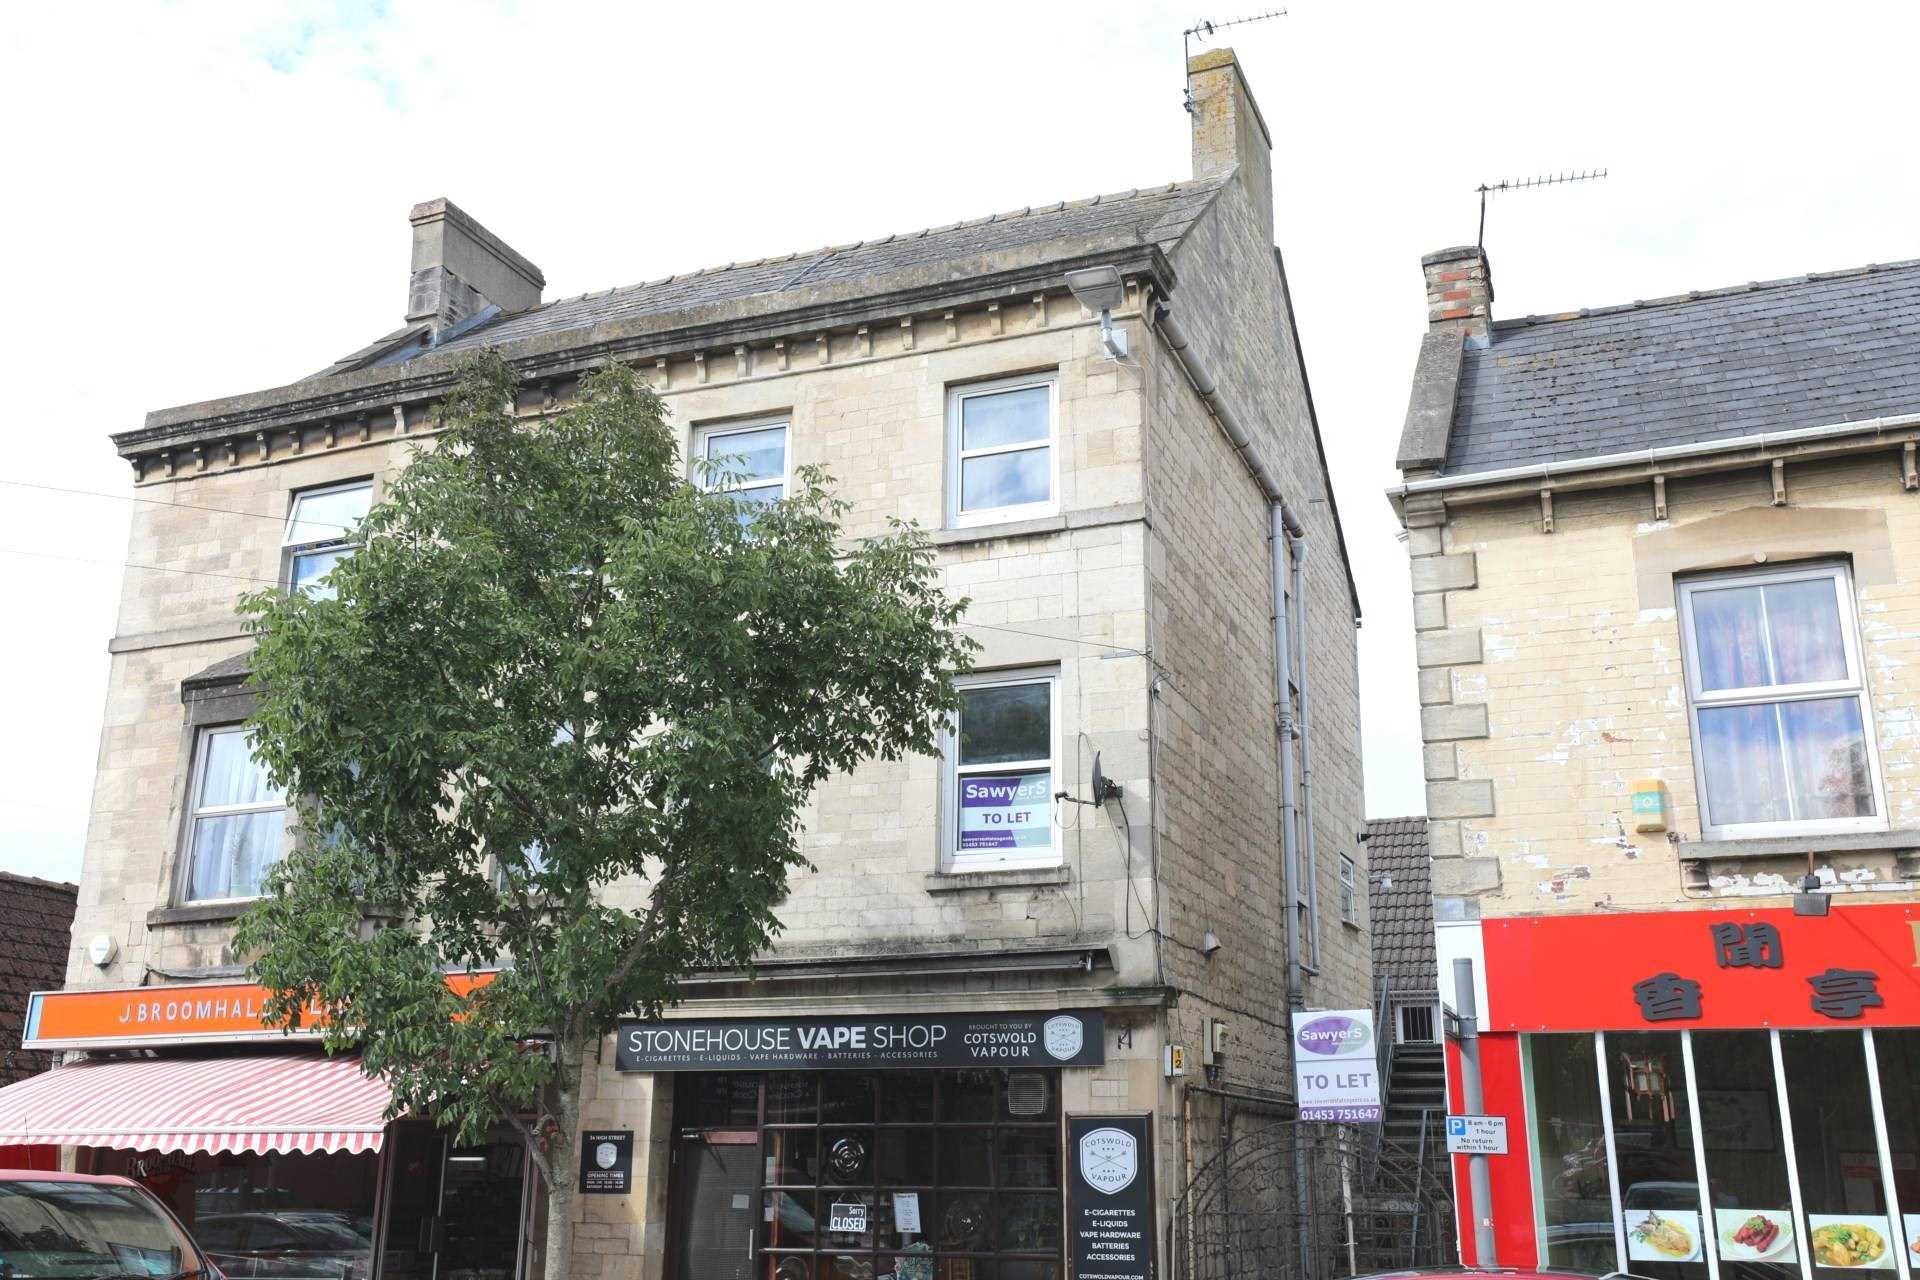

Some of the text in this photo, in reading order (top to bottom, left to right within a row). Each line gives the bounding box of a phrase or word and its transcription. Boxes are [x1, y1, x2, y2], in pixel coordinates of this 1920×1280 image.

[982, 811, 1031, 824] TO LET
[628, 1025, 946, 1052] STONEHOUSE VAPE SHOP
[963, 1032, 1037, 1044] COTSWOLD
[636, 1051, 938, 1062] E-CIGARETTES E-LIQUIDS VAPE HARDWARE BATTERIES ACCESSORIES
[970, 1045, 1030, 1057] VAPOUR
[1303, 1073, 1371, 1090] TO LET
[1301, 1108, 1379, 1121] 01453 751647
[1451, 1120, 1463, 1134] P
[1085, 1137, 1132, 1148] COTSWOLD
[1091, 1173, 1127, 1182] VAPOUR
[848, 1206, 865, 1217] Sorry
[1084, 1209, 1136, 1217] E-CIGARETTES
[831, 1217, 865, 1230] CLOSED
[1092, 1220, 1128, 1228] E-LIQUIDS
[1091, 1242, 1130, 1250] BATTERIES
[1086, 1253, 1136, 1261] ACCESSORIES
